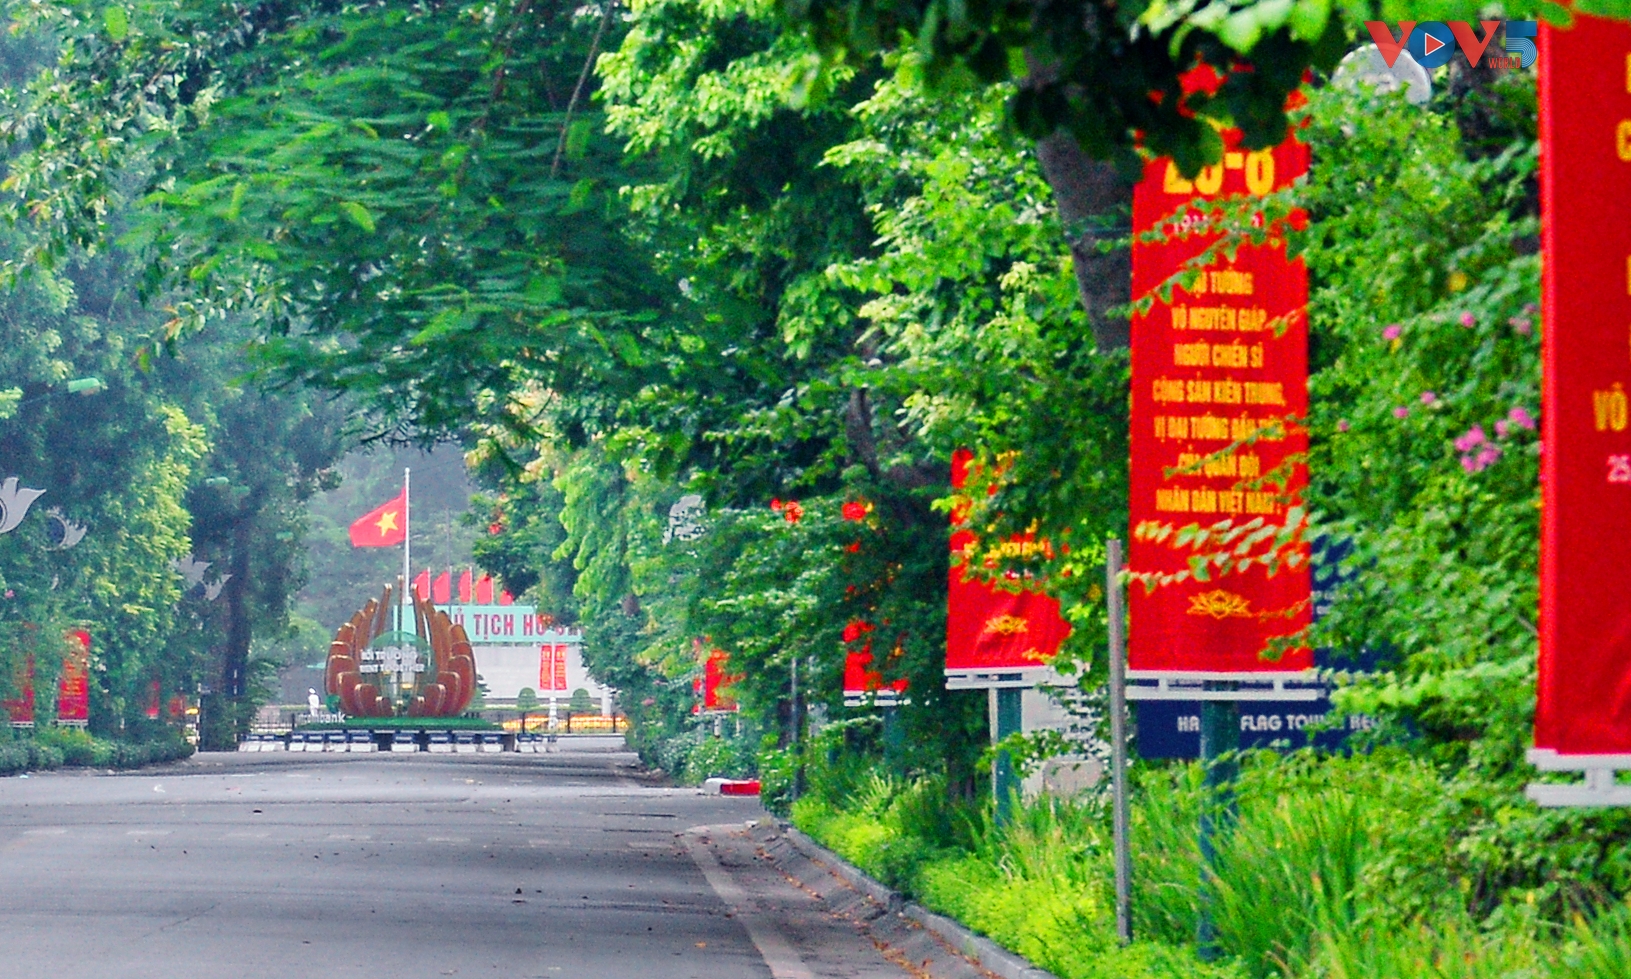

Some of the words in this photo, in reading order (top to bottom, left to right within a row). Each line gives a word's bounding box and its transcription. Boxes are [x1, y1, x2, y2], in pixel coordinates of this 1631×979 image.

[1209, 267, 1254, 295] TƯỚNG
[1171, 303, 1187, 330] VÕ
[1189, 304, 1236, 331] NGUYÊN
[1238, 304, 1267, 332] GIÁP
[1212, 338, 1248, 367] CHIẾN
[1152, 375, 1184, 406] CỘNG
[1186, 371, 1212, 403] SẢN
[1213, 375, 1241, 404] KIÊN
[1243, 381, 1287, 407] TRUNG,
[1593, 381, 1628, 431] VÕ
[1153, 415, 1166, 443] VỊ
[1190, 410, 1228, 440] TƯỚNG
[1156, 485, 1190, 511] NHÂN
[1191, 485, 1217, 513] DÂN
[473, 613, 514, 640] TỊCH
[1240, 714, 1282, 731] FLAG
